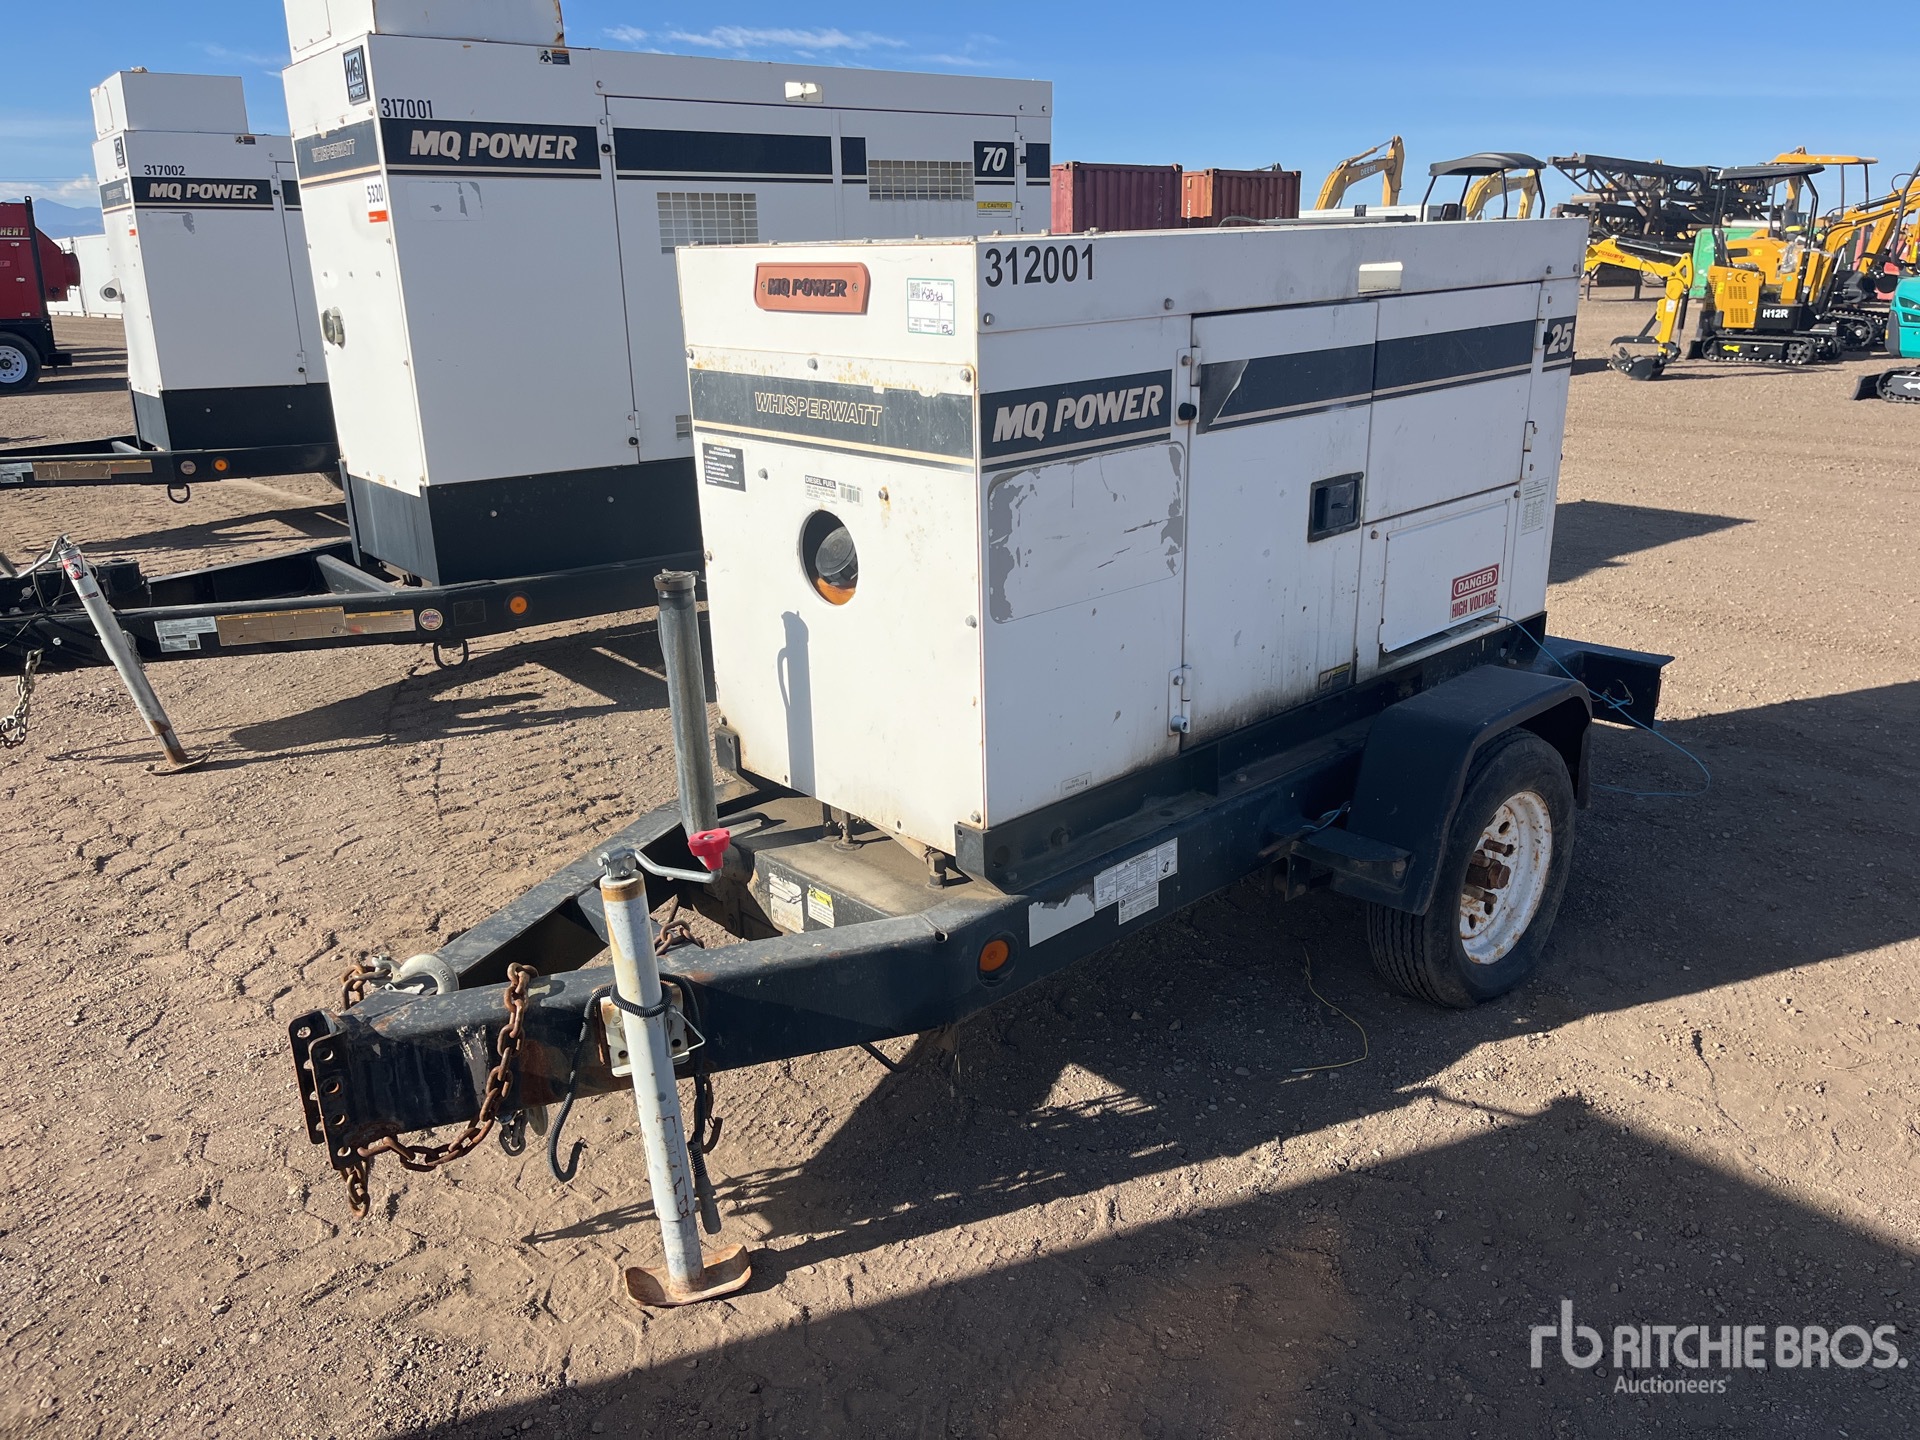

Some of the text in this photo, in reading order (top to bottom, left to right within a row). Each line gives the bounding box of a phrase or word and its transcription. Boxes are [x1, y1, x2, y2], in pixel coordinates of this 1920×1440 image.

[381, 98, 433, 118] 317001
[410, 130, 578, 161] MQ POWER
[982, 147, 1007, 172] 70
[1360, 164, 1377, 176] DEERE
[144, 165, 186, 176] 317002
[149, 183, 258, 200] MQ POWER
[367, 184, 384, 204] 5320
[985, 243, 1094, 288] 312001
[767, 278, 848, 298] MQ POWER
[1762, 308, 1789, 319] H12R
[1547, 322, 1574, 355] 25
[755, 391, 882, 427] WHISPERWATT
[992, 384, 1164, 442] MQ POWER
[805, 476, 823, 487] DIESEL
[822, 479, 836, 489] FUEL
[1458, 571, 1493, 594] DANGER
[1451, 589, 1497, 619] HIGH VOLTAGE
